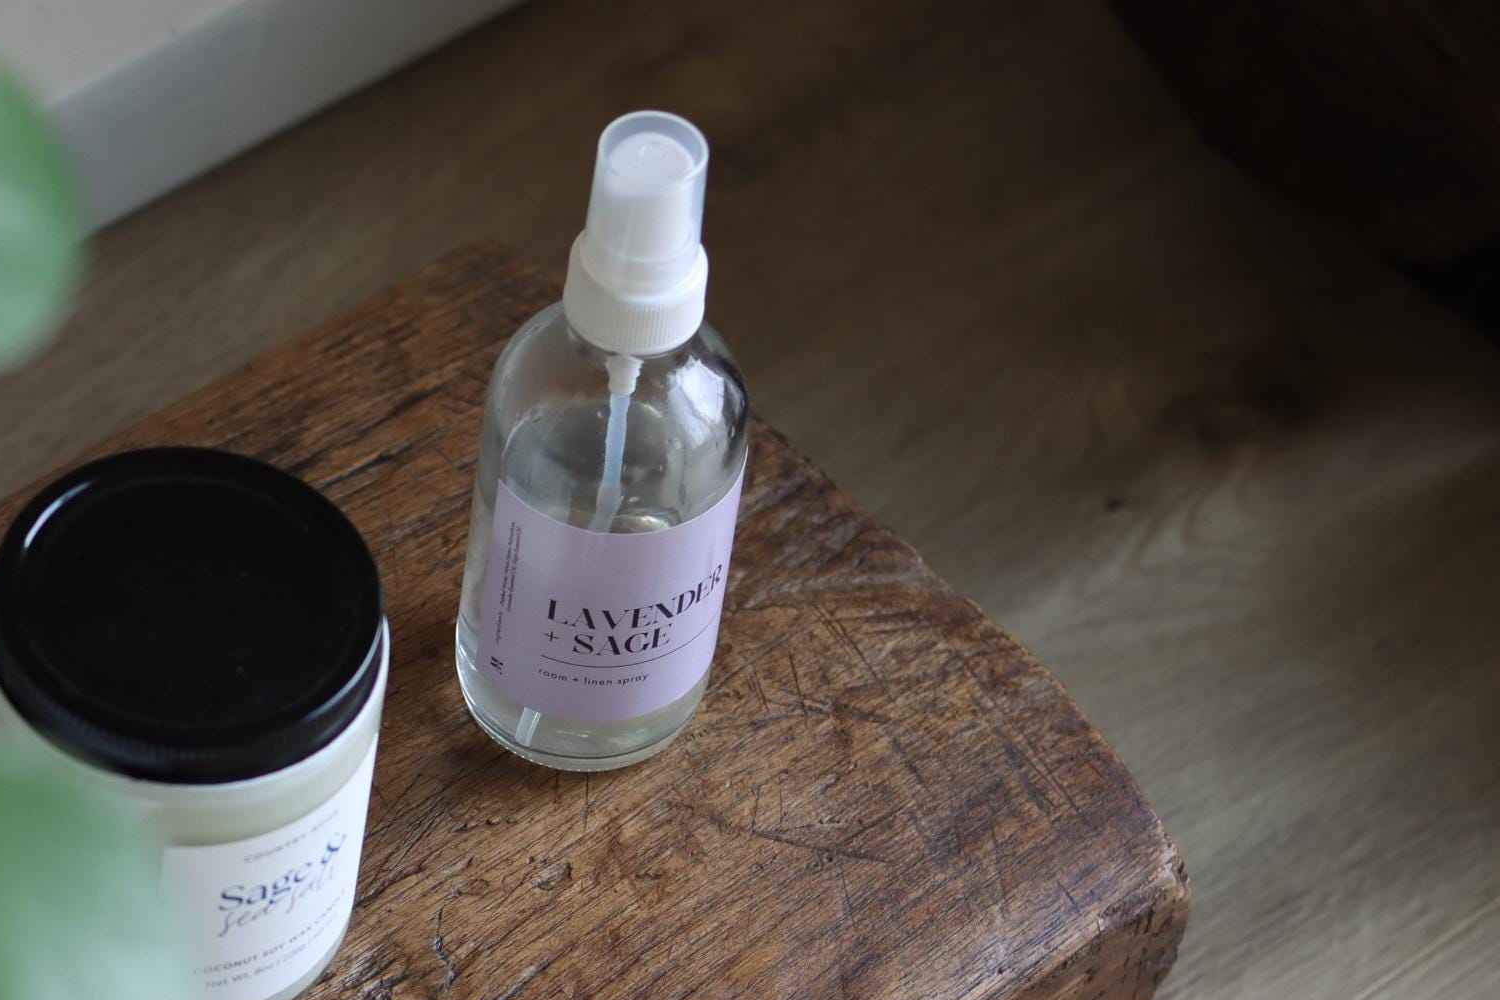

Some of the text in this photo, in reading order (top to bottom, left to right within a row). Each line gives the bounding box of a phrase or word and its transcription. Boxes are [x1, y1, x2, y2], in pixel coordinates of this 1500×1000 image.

[546, 563, 723, 630] LAVENDER
[543, 623, 673, 656] + SAGE
[538, 668, 568, 683] room
[583, 676, 613, 688] linen
[617, 671, 649, 687] spray
[217, 860, 312, 911] Sage
